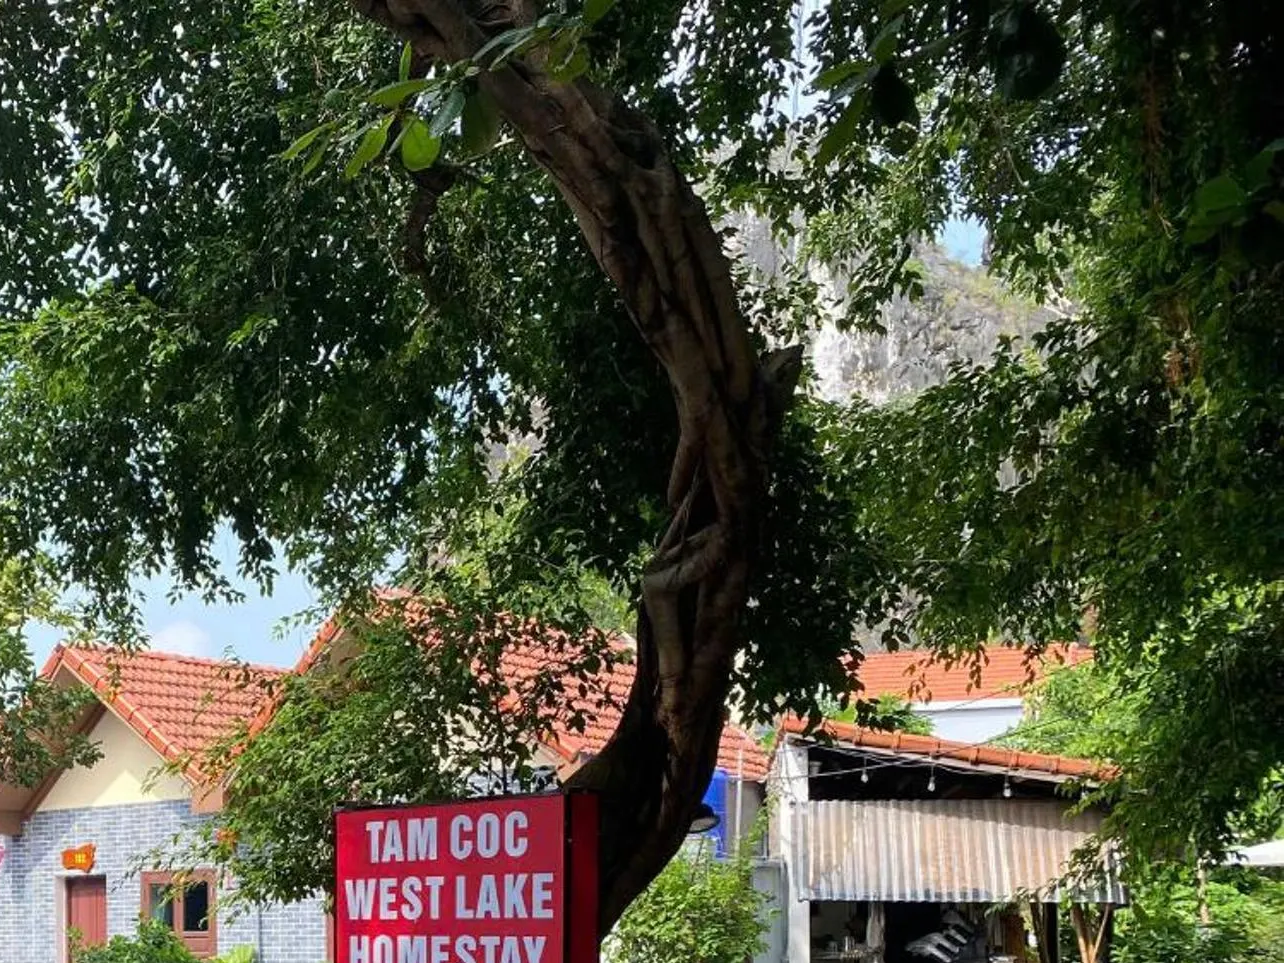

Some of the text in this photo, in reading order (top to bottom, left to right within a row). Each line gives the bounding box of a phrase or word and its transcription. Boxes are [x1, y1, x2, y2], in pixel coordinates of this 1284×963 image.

[366, 811, 528, 864] TAM COC
[344, 872, 554, 921] WEST LAKE
